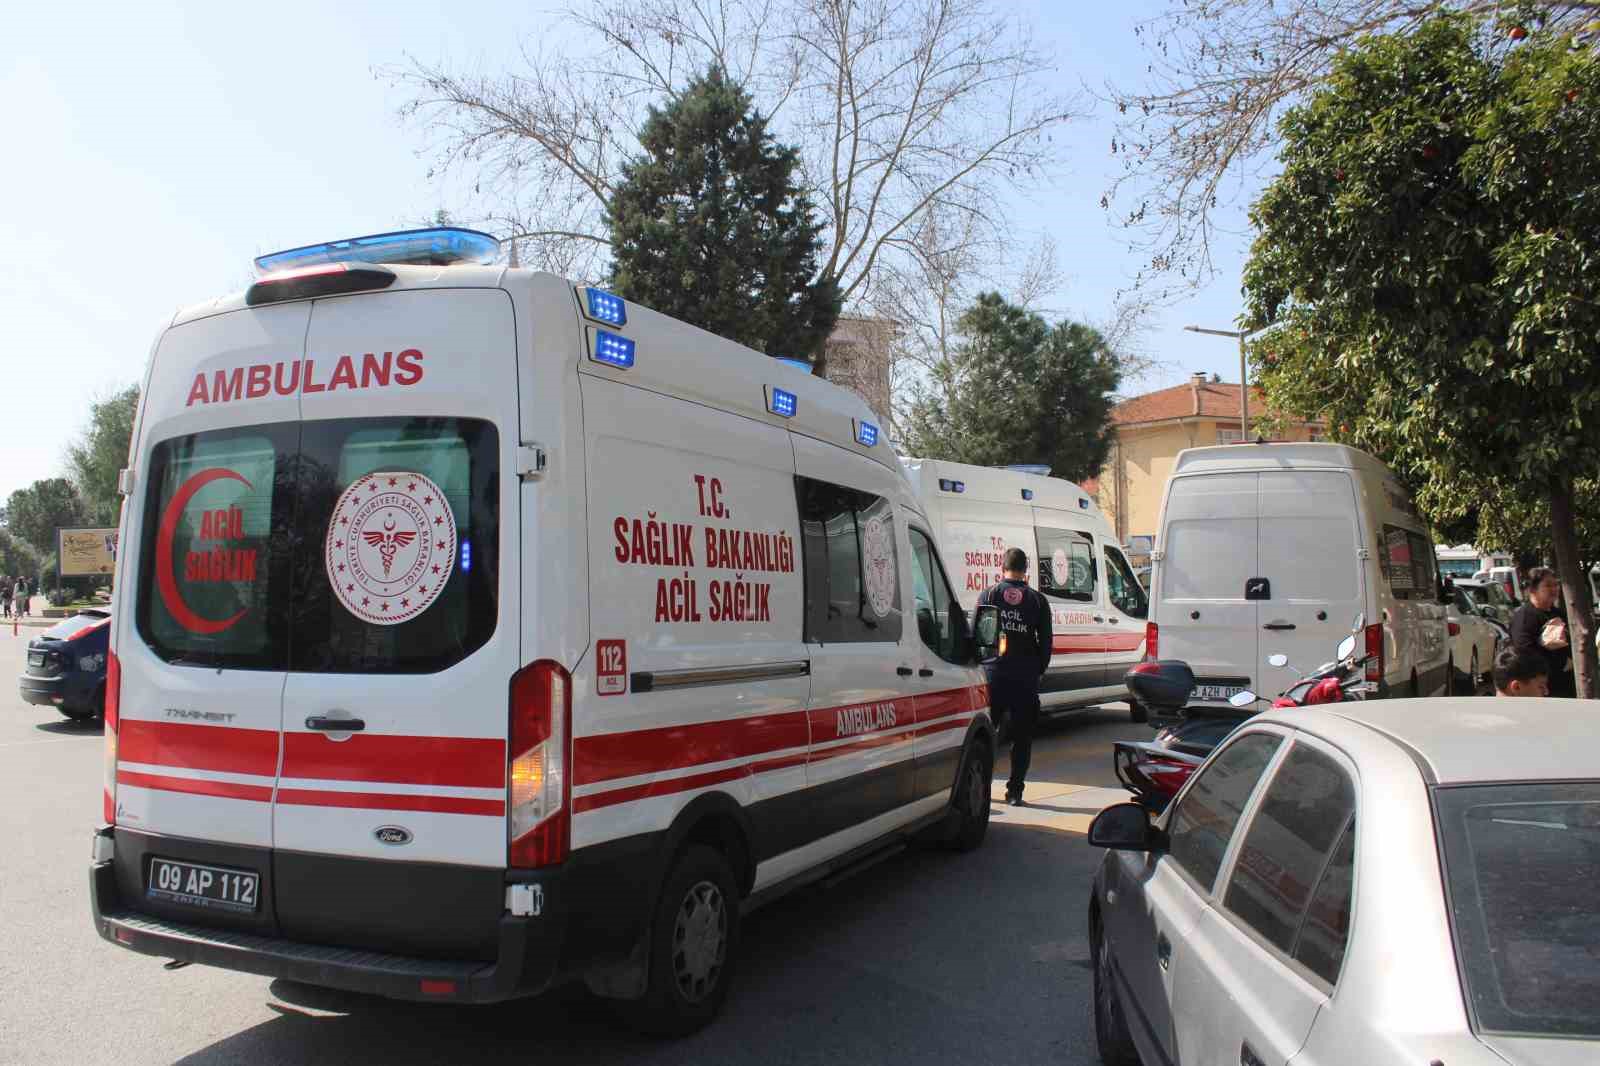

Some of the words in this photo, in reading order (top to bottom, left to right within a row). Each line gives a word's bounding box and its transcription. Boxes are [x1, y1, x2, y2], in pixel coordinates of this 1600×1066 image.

[186, 348, 424, 407] AMBULANS
[694, 474, 730, 519] T.C.
[200, 504, 246, 541] ACİL
[614, 510, 695, 567] SAĞLIK
[704, 526, 794, 573] BAKANLIĞI
[184, 544, 257, 582] SAĞLIK
[655, 571, 701, 622] ACİL
[709, 573, 771, 622] SAĞLIK
[600, 645, 622, 671] 112
[836, 702, 897, 737] AMBULANS
[159, 864, 181, 890] 09
[185, 868, 213, 895] AP
[222, 873, 255, 903] 112
